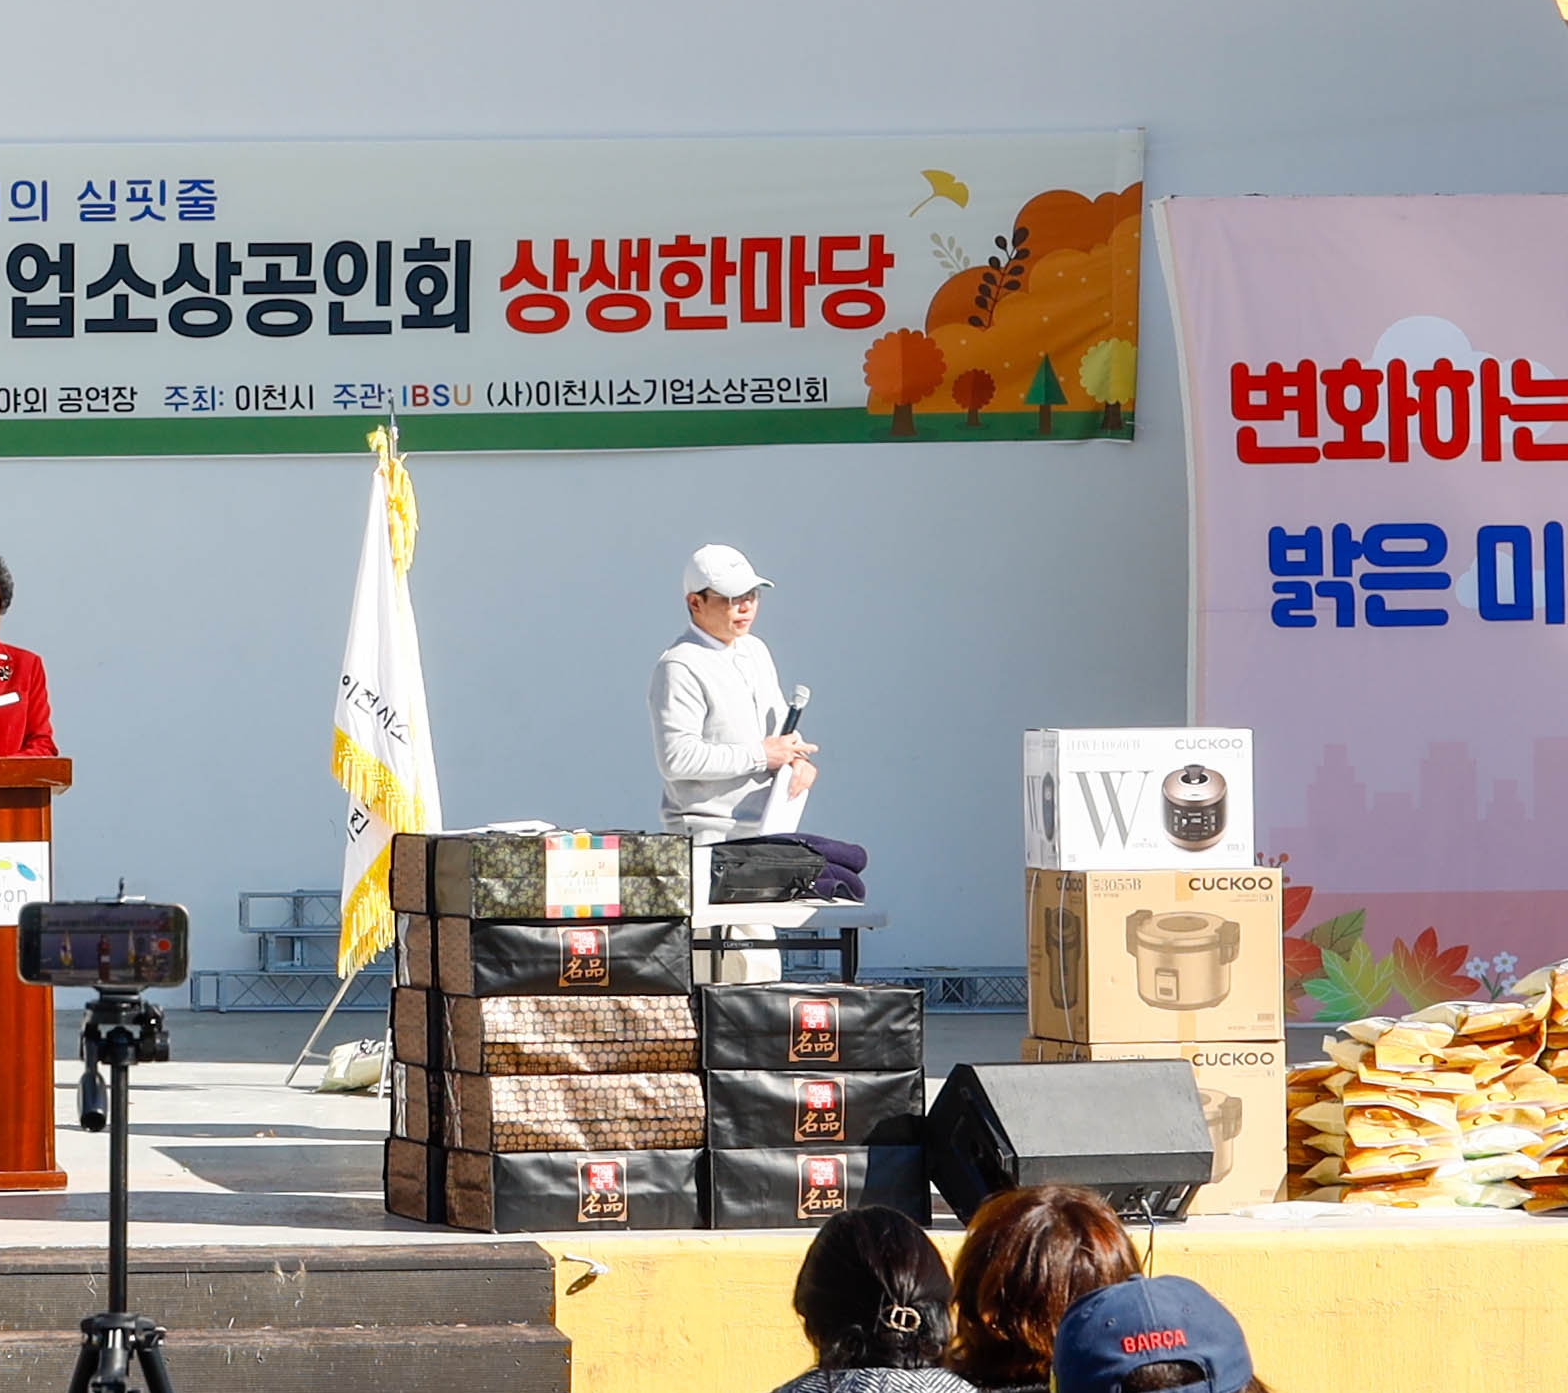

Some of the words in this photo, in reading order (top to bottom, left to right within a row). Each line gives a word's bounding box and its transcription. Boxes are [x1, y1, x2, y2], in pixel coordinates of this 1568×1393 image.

[77, 179, 217, 222] 실핏줄
[500, 234, 895, 336] 상생한마당
[58, 386, 138, 414] 공연장
[164, 385, 224, 412] 주최:
[235, 384, 314, 411] 이천시
[333, 383, 392, 410] 주관:
[402, 383, 472, 407] IBSU
[487, 377, 828, 408] (사)이천시소기업소상공인회
[1267, 520, 1452, 629] 밝은
[1174, 738, 1244, 750] CUCKOO
[1069, 770, 1154, 850] W
[1188, 876, 1274, 892] CUCKOO
[564, 957, 605, 979] 名品
[793, 1031, 835, 1053] 名品
[1191, 1051, 1275, 1067] CUCKOO
[799, 1111, 841, 1133] 名品
[582, 1192, 624, 1214] 名品
[800, 1188, 843, 1210] 名品
[1122, 1328, 1188, 1354] BARÇA
